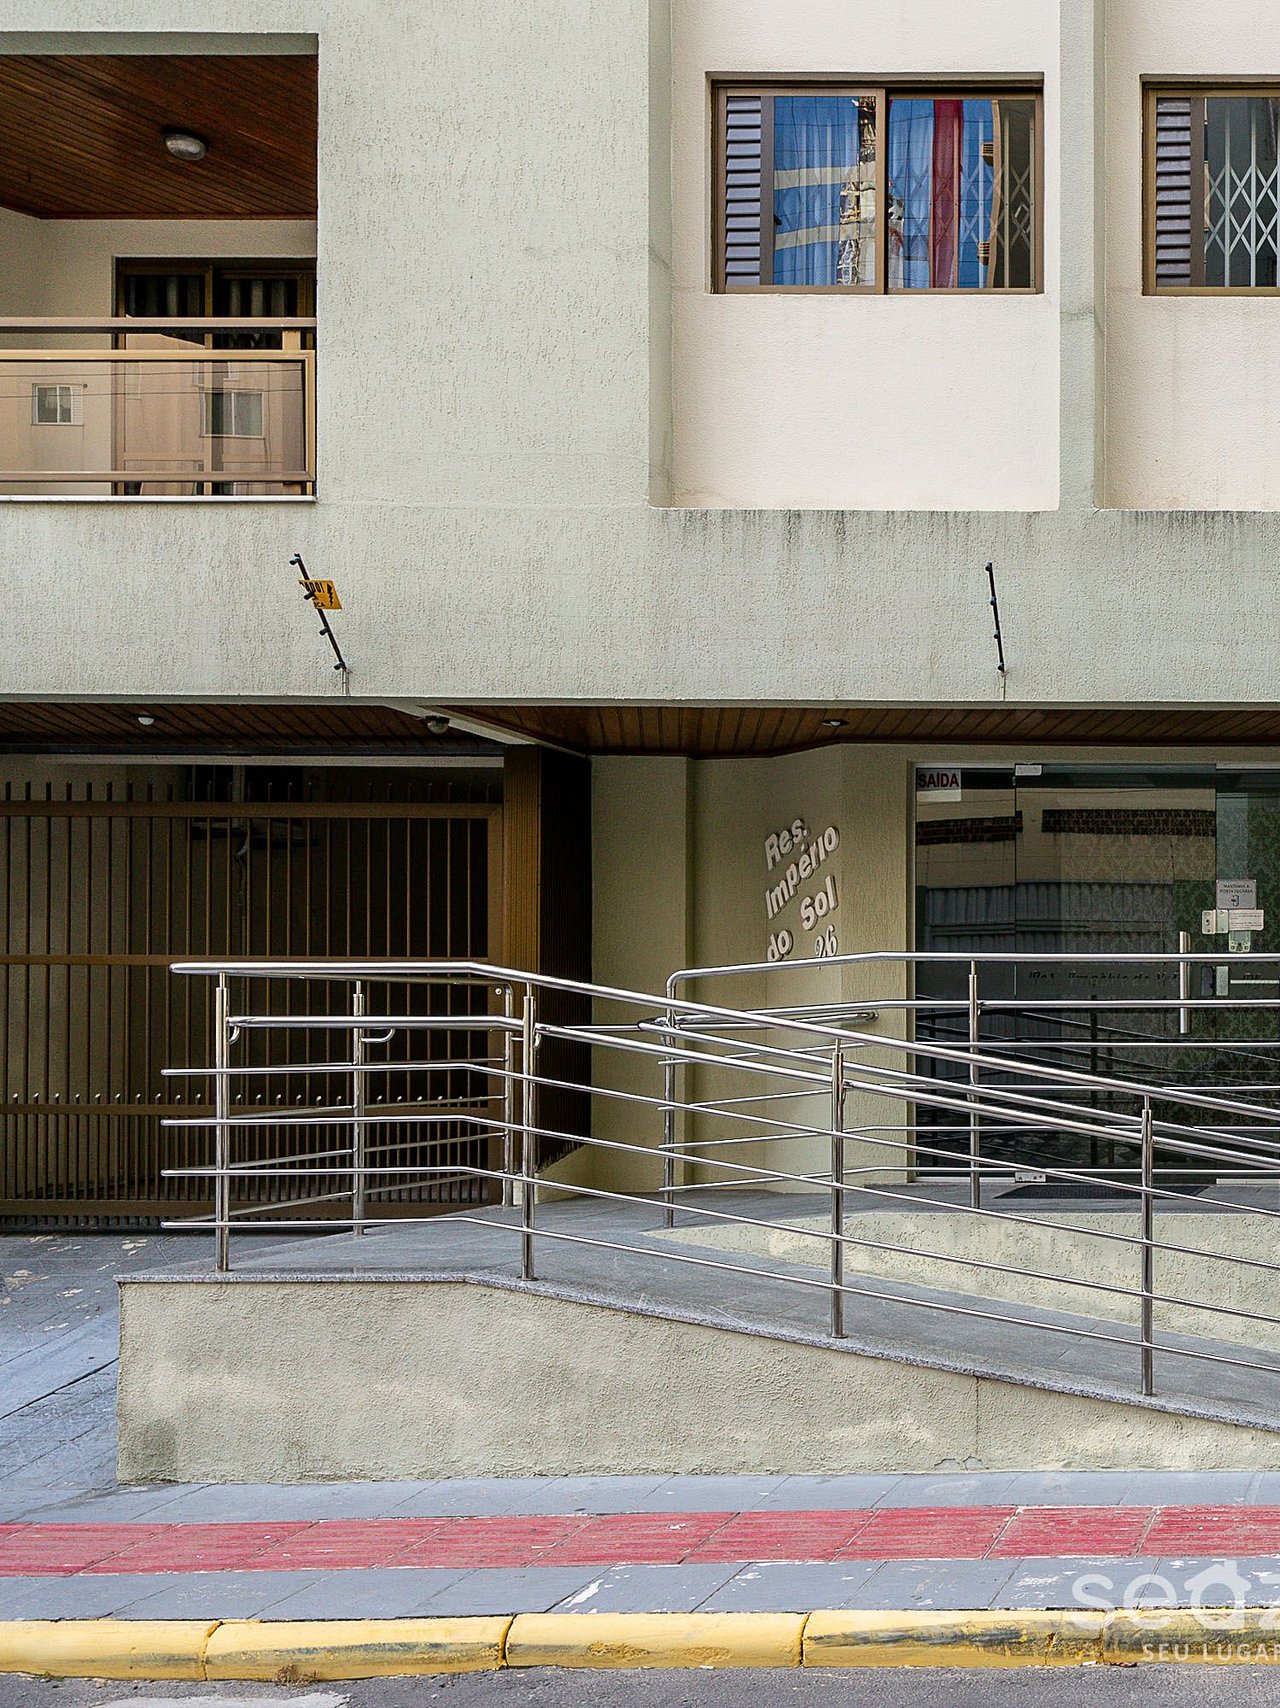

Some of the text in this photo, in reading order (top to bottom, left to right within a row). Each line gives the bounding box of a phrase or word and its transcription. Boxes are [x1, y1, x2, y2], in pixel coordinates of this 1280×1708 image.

[765, 819, 808, 870] Res.
[765, 826, 840, 919] Império
[767, 875, 838, 962] do Sol
[814, 924, 838, 959] 26
